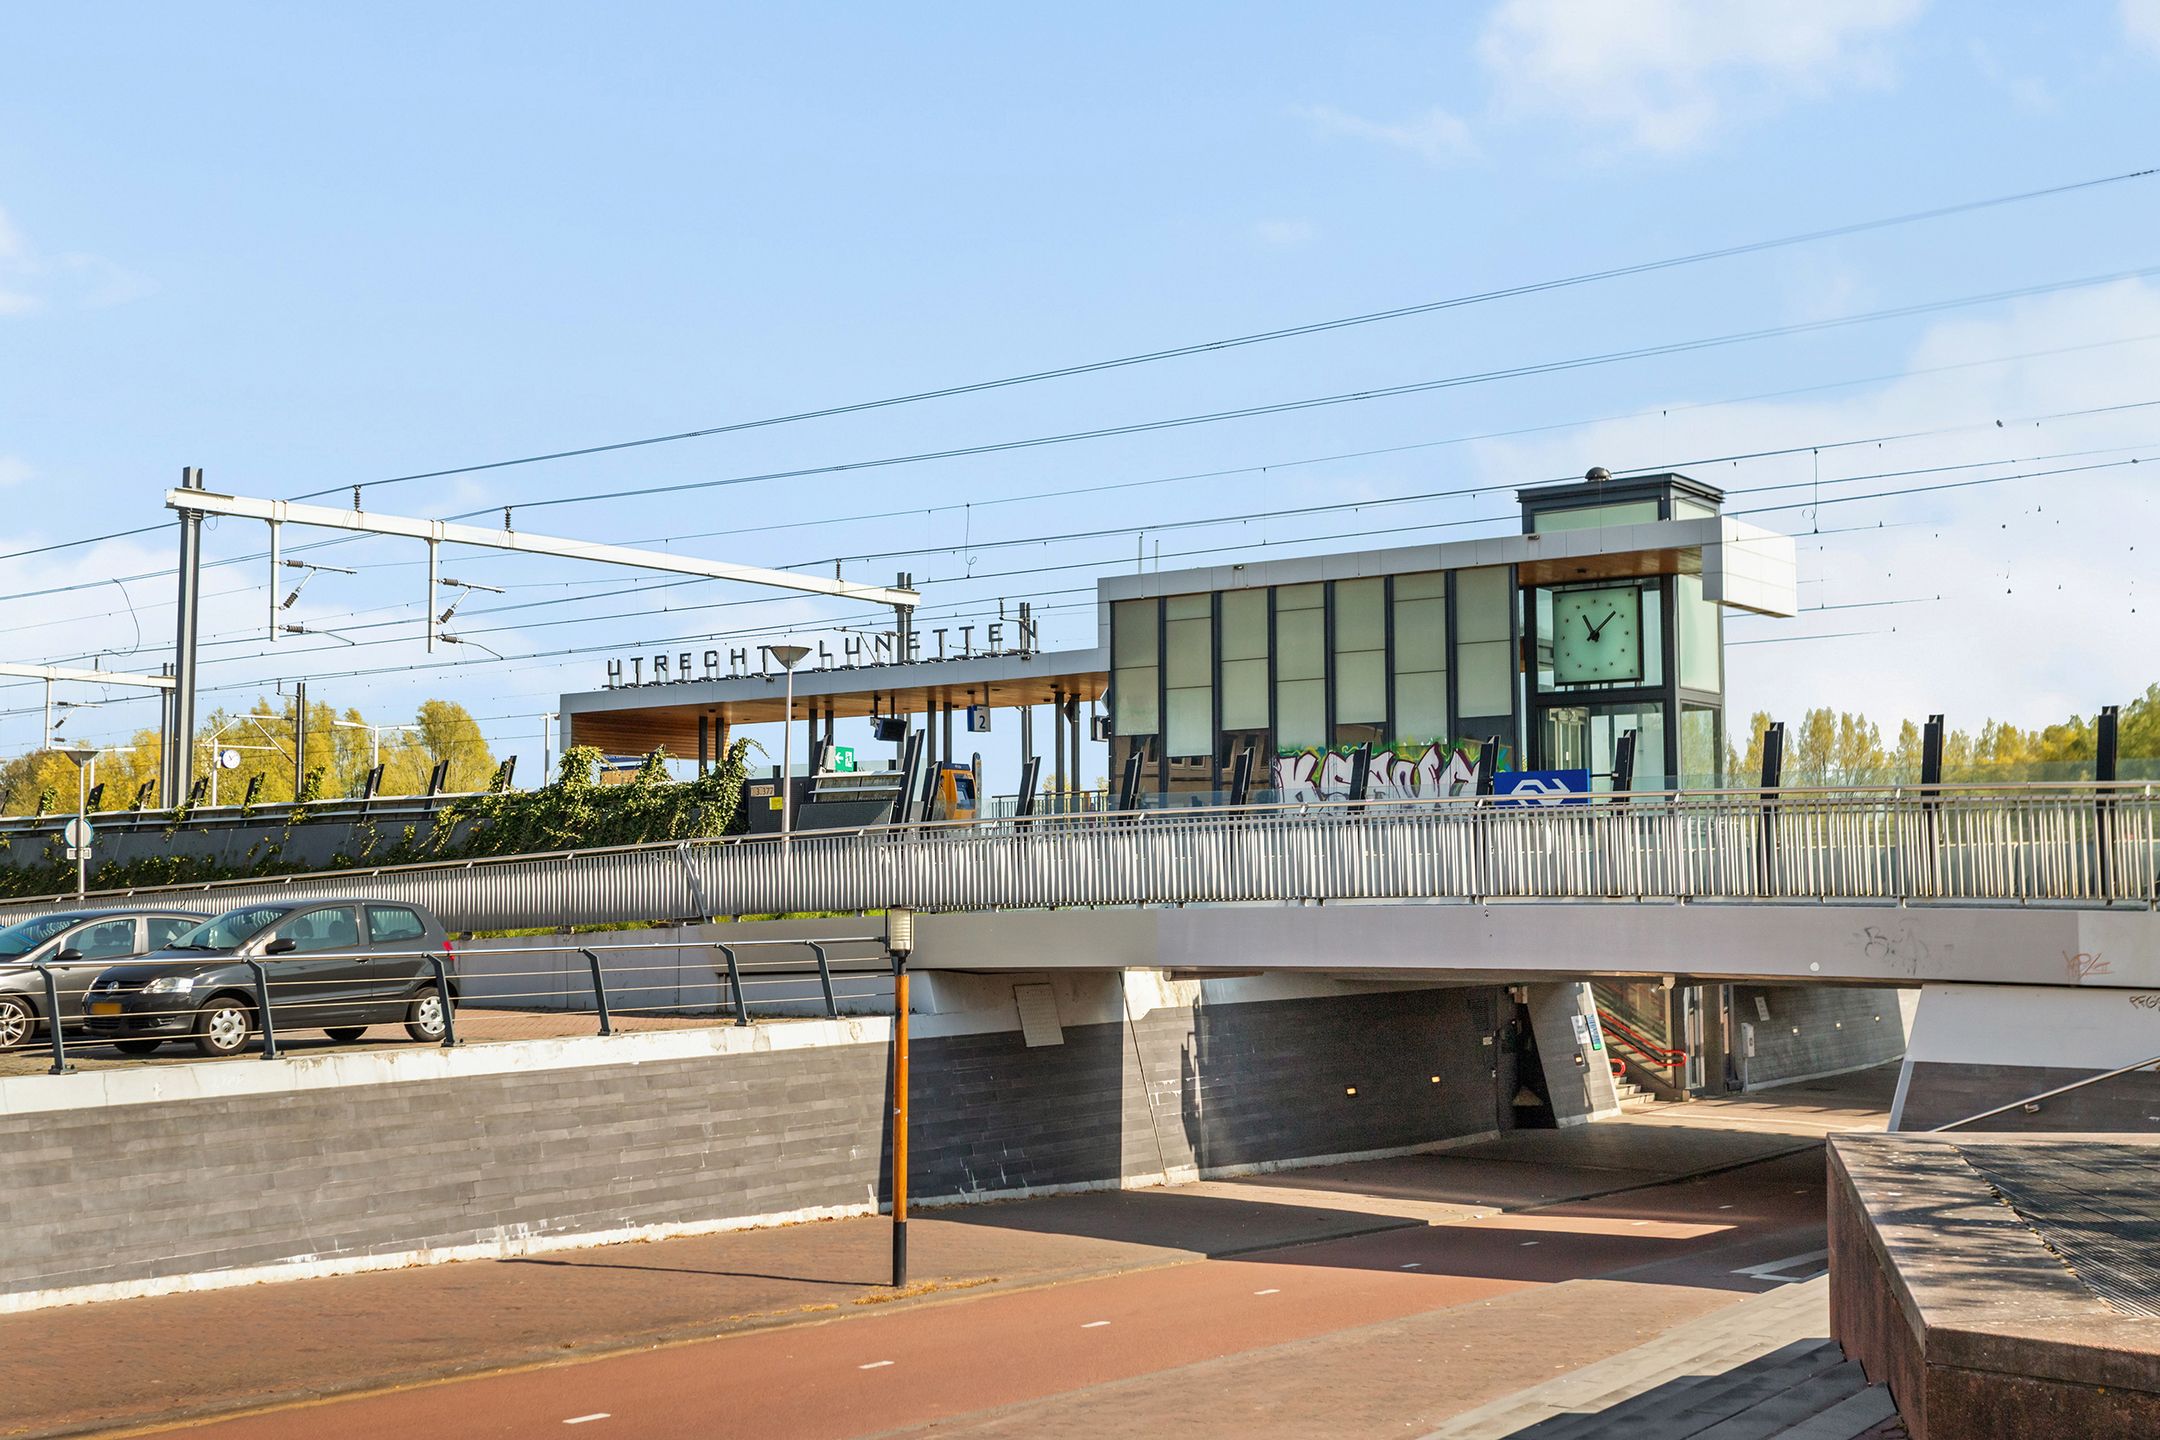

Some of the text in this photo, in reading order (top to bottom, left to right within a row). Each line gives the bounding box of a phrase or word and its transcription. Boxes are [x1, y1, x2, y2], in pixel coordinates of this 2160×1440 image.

[607, 620, 1039, 677] UTRECHT LUNETTEN
[979, 715, 986, 729] 2
